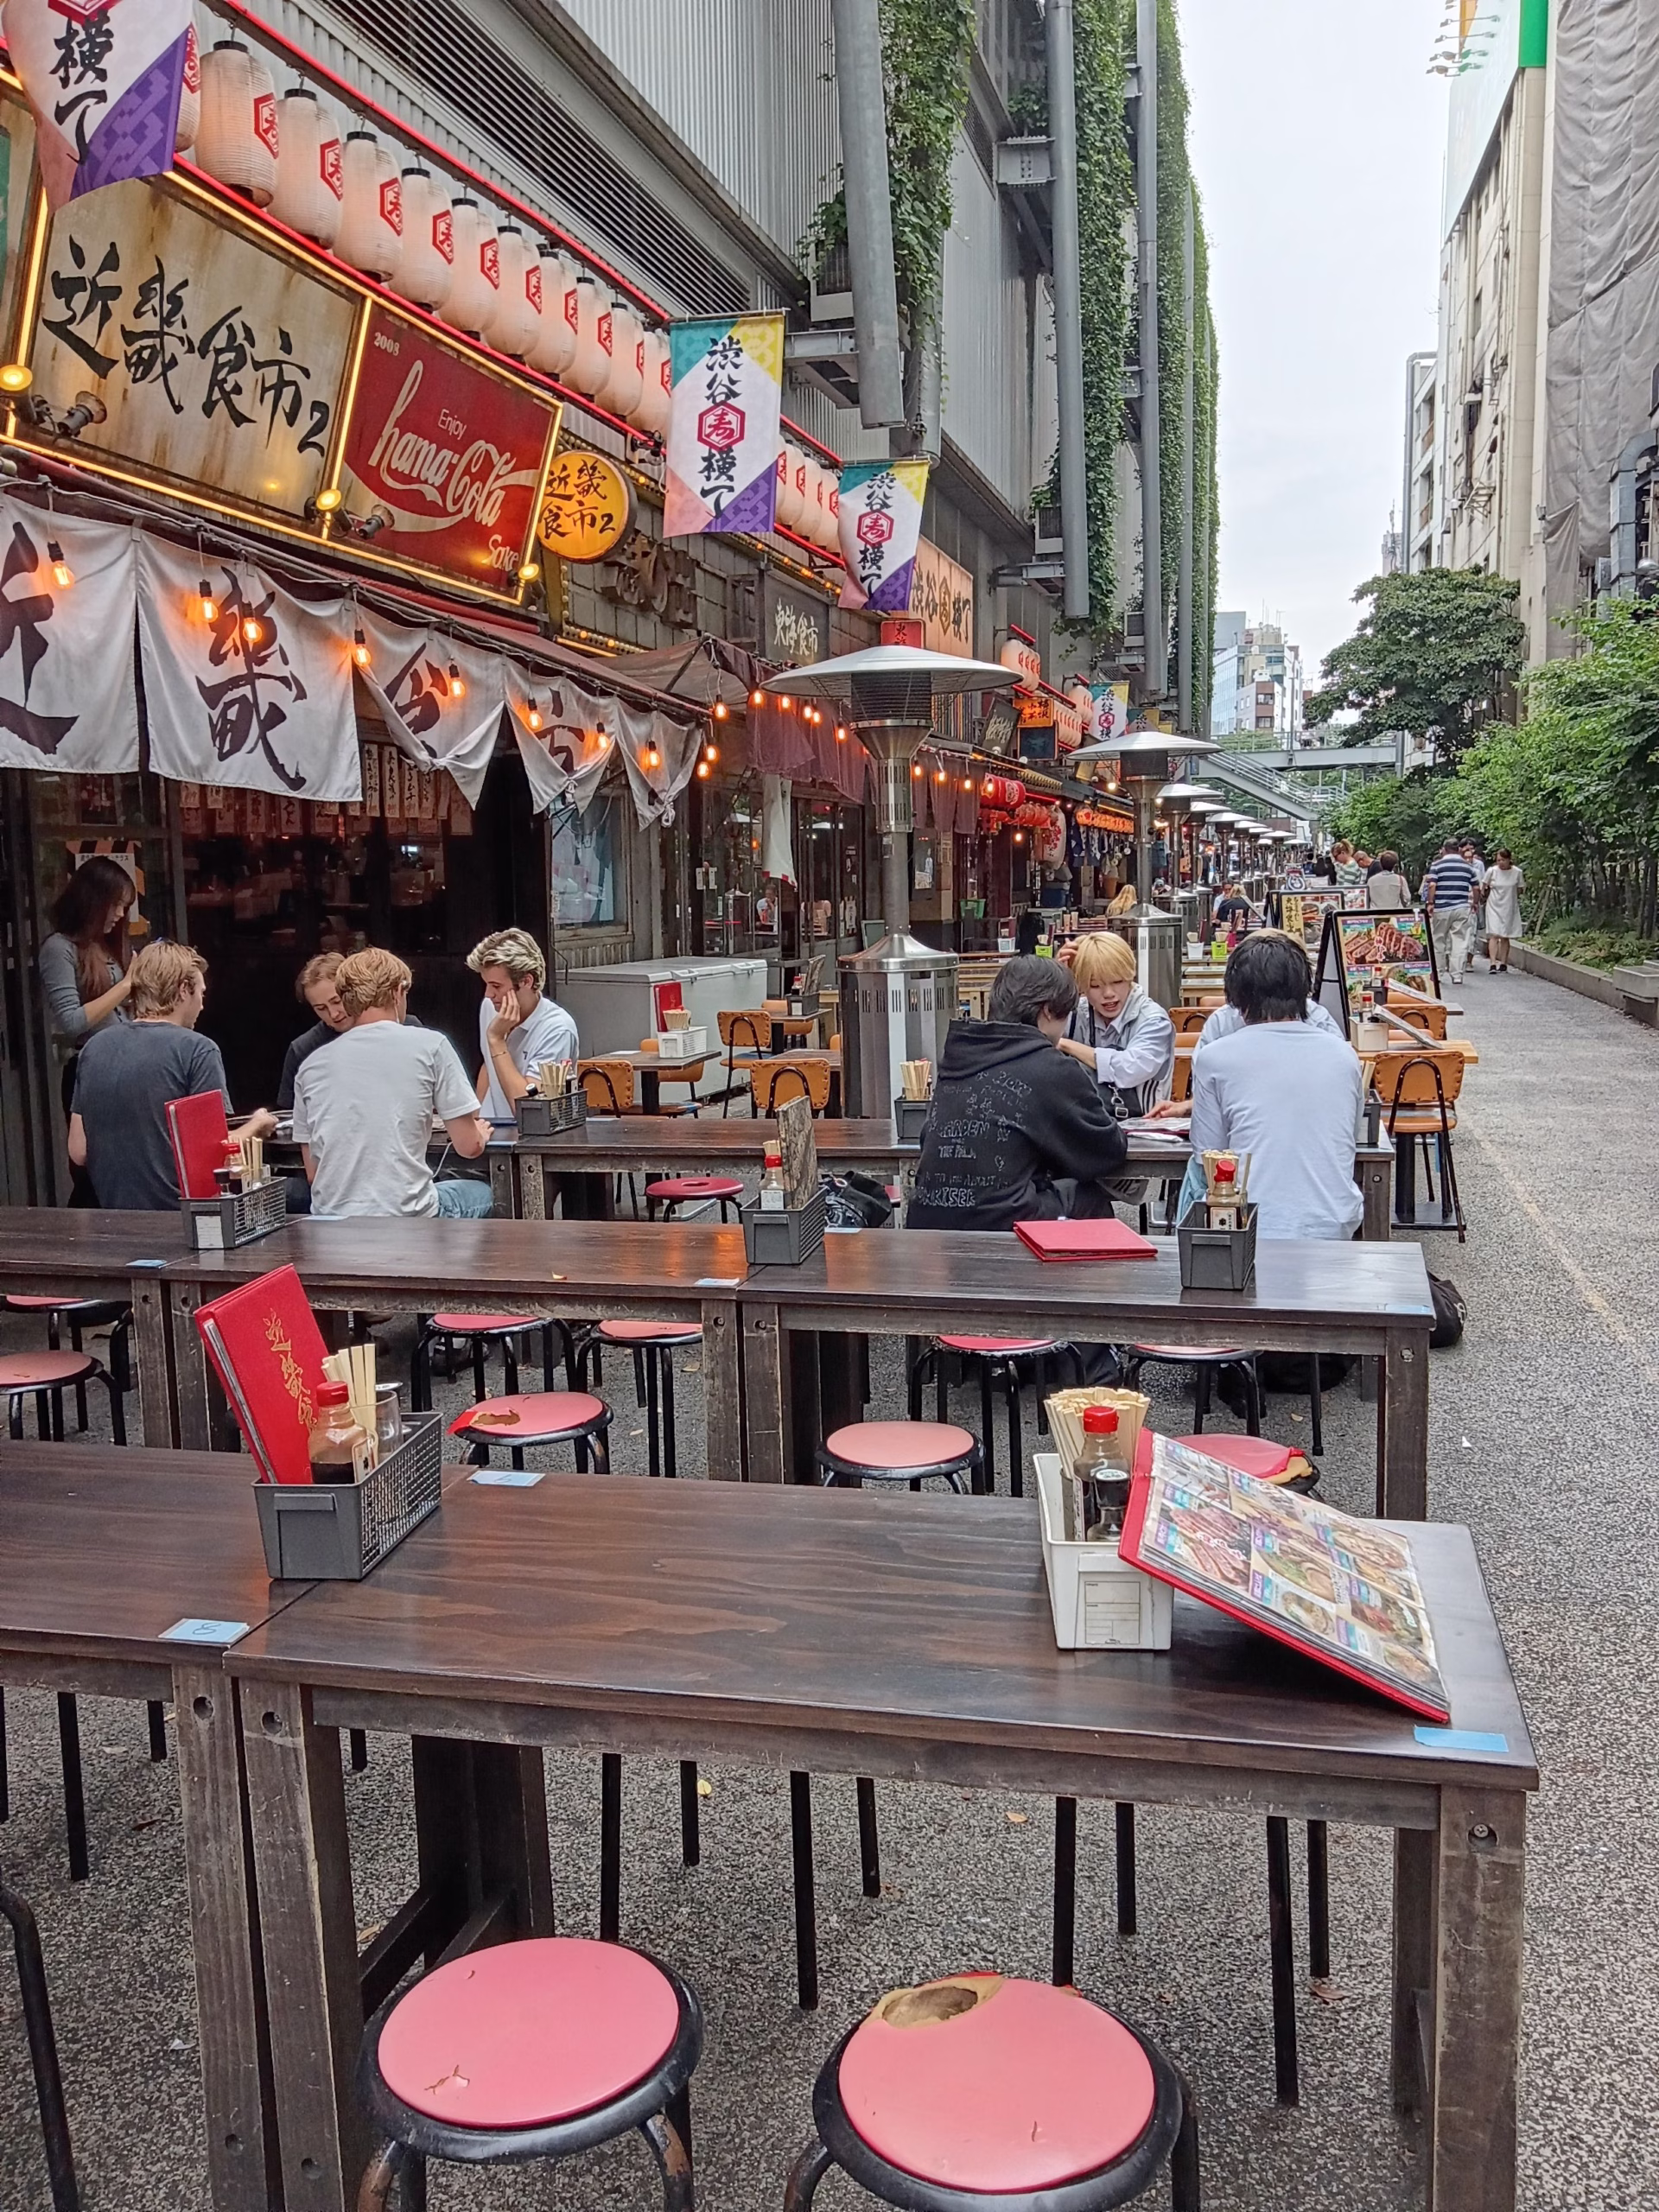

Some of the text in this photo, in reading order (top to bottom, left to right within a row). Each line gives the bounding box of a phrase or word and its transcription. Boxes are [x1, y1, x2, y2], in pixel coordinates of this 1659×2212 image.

[42, 235, 329, 459] 近畿食市2
[373, 332, 400, 356] 2008
[437, 408, 467, 441] Enjoy
[546, 459, 607, 501] 近畿
[540, 499, 616, 540] 食市2
[488, 534, 519, 571] Sake
